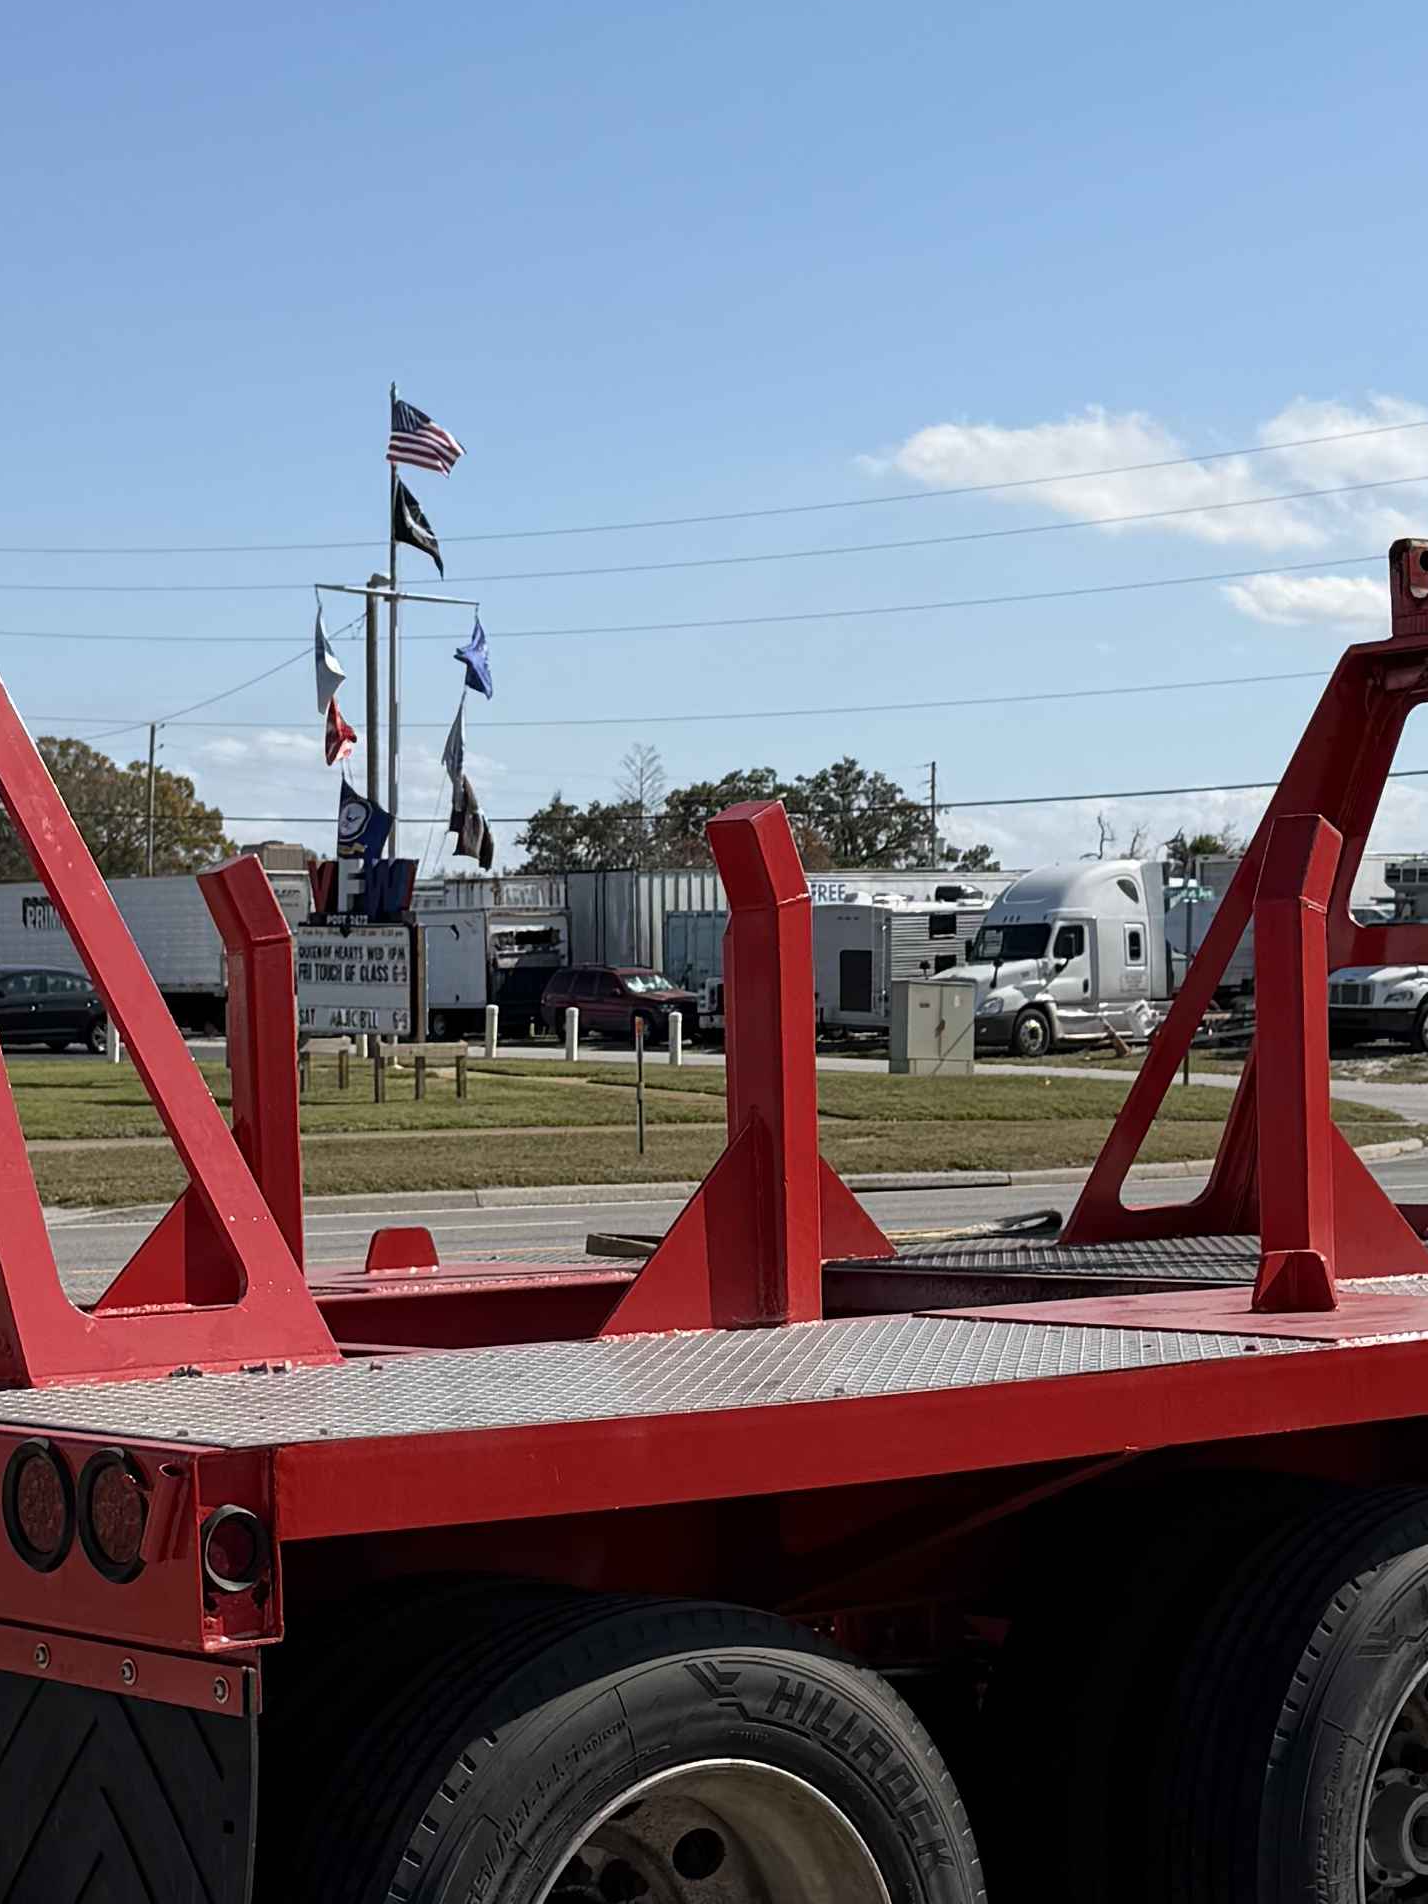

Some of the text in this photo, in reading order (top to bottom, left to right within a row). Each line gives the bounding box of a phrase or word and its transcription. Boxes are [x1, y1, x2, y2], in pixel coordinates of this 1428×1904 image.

[307, 858, 419, 920] VFW
[326, 914, 346, 926] POST
[298, 945, 321, 959] QUEEN
[334, 945, 363, 960] HEARTS
[367, 946, 385, 961] WED
[298, 963, 311, 981] FRI
[315, 963, 341, 982] TOUCH
[344, 964, 355, 982] OF
[360, 964, 389, 983] CLASS
[298, 1008, 315, 1026] SAT
[765, 1675, 955, 1870] HILLROCK
